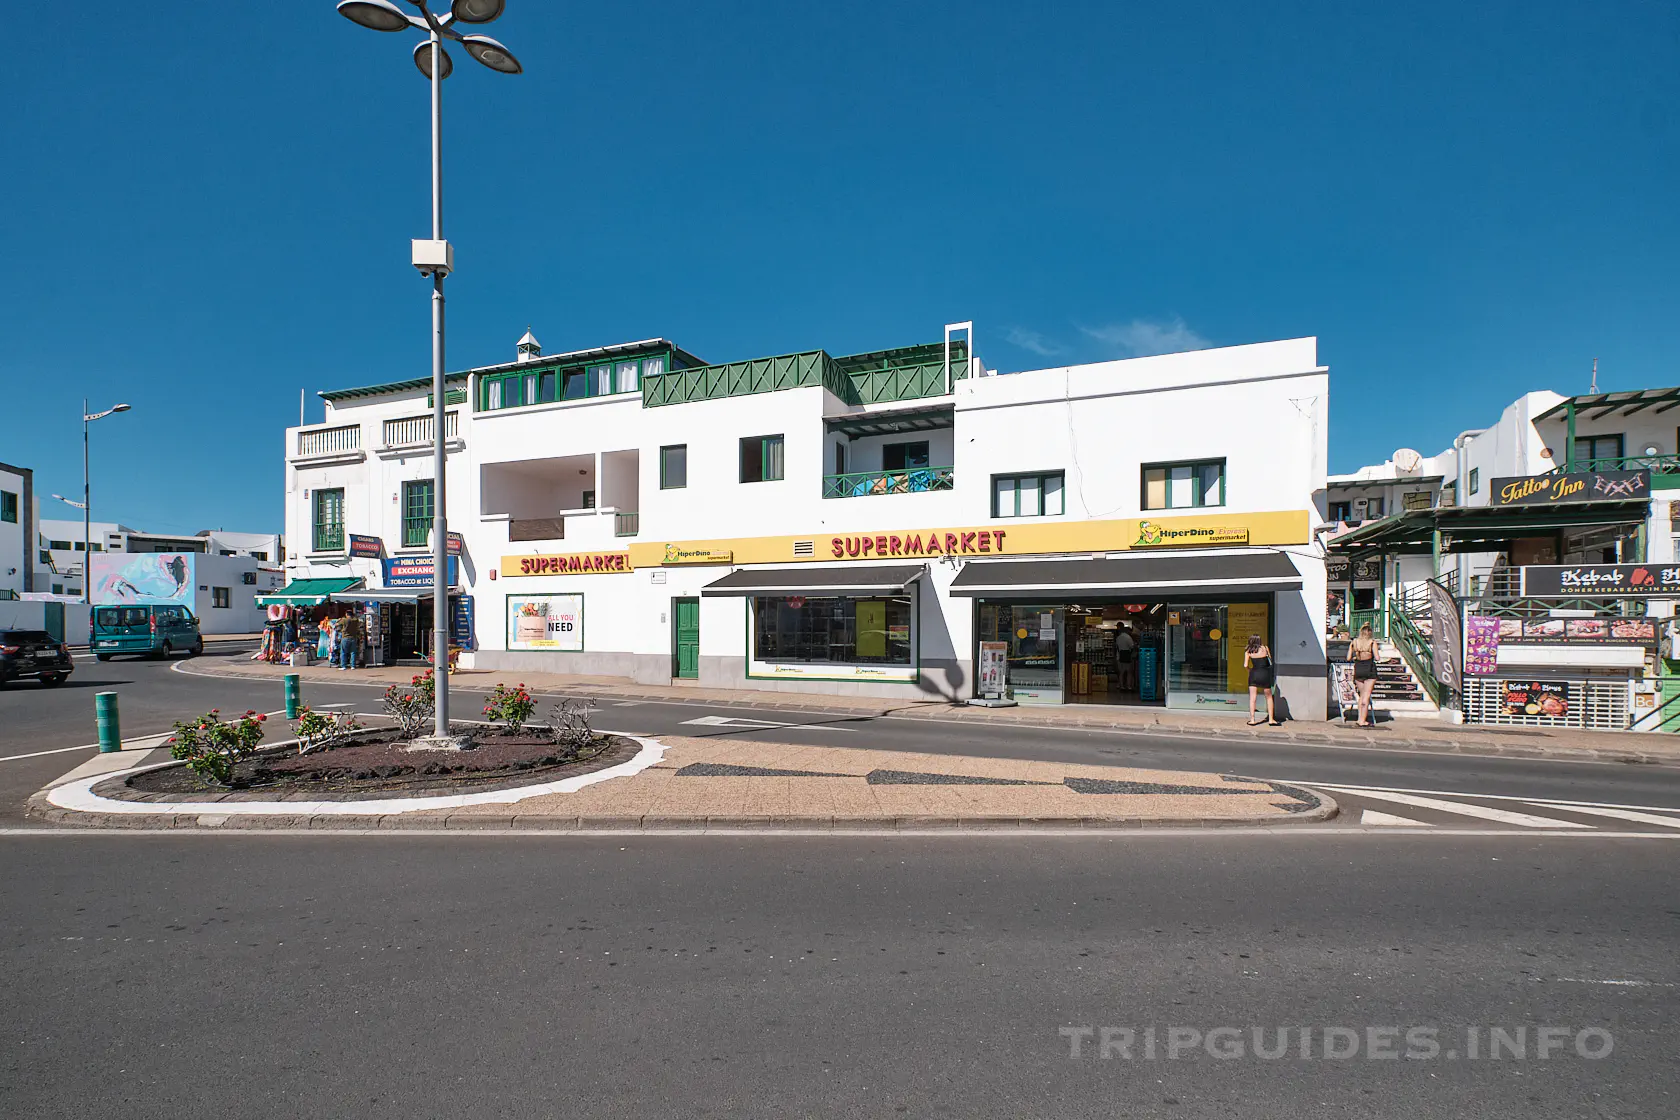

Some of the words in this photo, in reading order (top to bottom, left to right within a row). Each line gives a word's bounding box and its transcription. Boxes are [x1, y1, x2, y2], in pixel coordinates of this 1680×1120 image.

[1550, 477, 1585, 500] Inn
[1159, 528, 1215, 539] HiperDino
[831, 530, 1006, 558] SUPERMARKET
[677, 550, 711, 558] HiperDino
[415, 557, 434, 565] CHOIC
[520, 554, 632, 574] SUPERMARKET
[397, 566, 434, 575] EXCHANG
[1560, 568, 1624, 587] Kebab
[1661, 567, 1680, 585] H
[548, 622, 573, 632] NEED
